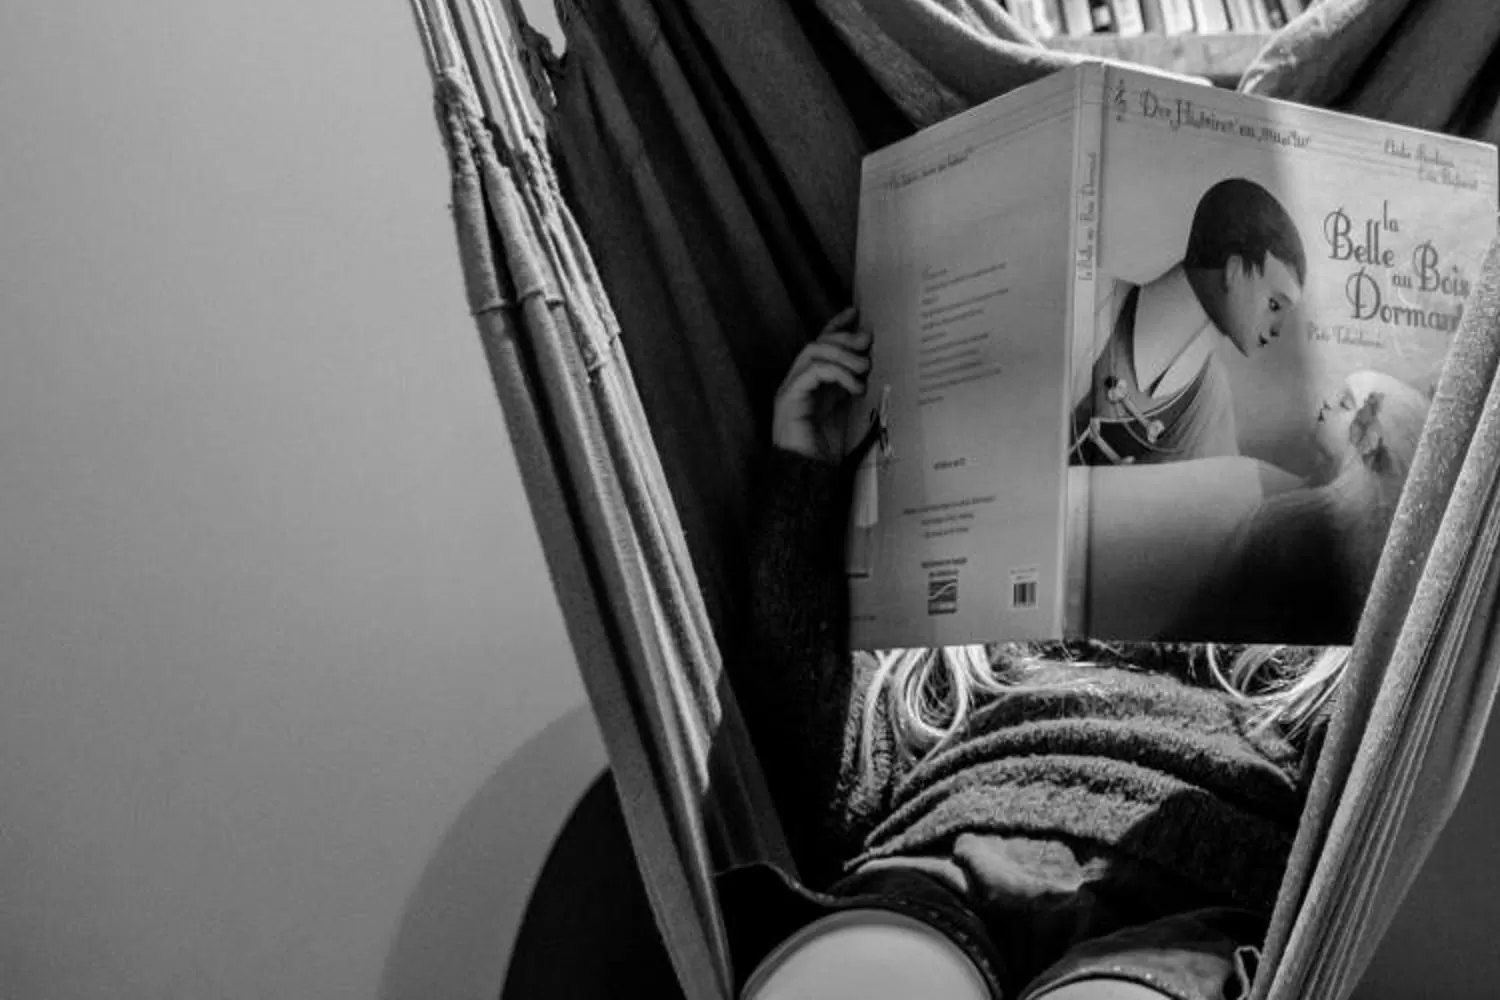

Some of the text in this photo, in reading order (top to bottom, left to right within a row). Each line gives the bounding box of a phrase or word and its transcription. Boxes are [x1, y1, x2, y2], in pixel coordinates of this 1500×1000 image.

[1383, 199, 1399, 232] la
[1323, 207, 1395, 268] Belle
[1391, 273, 1413, 289] au
